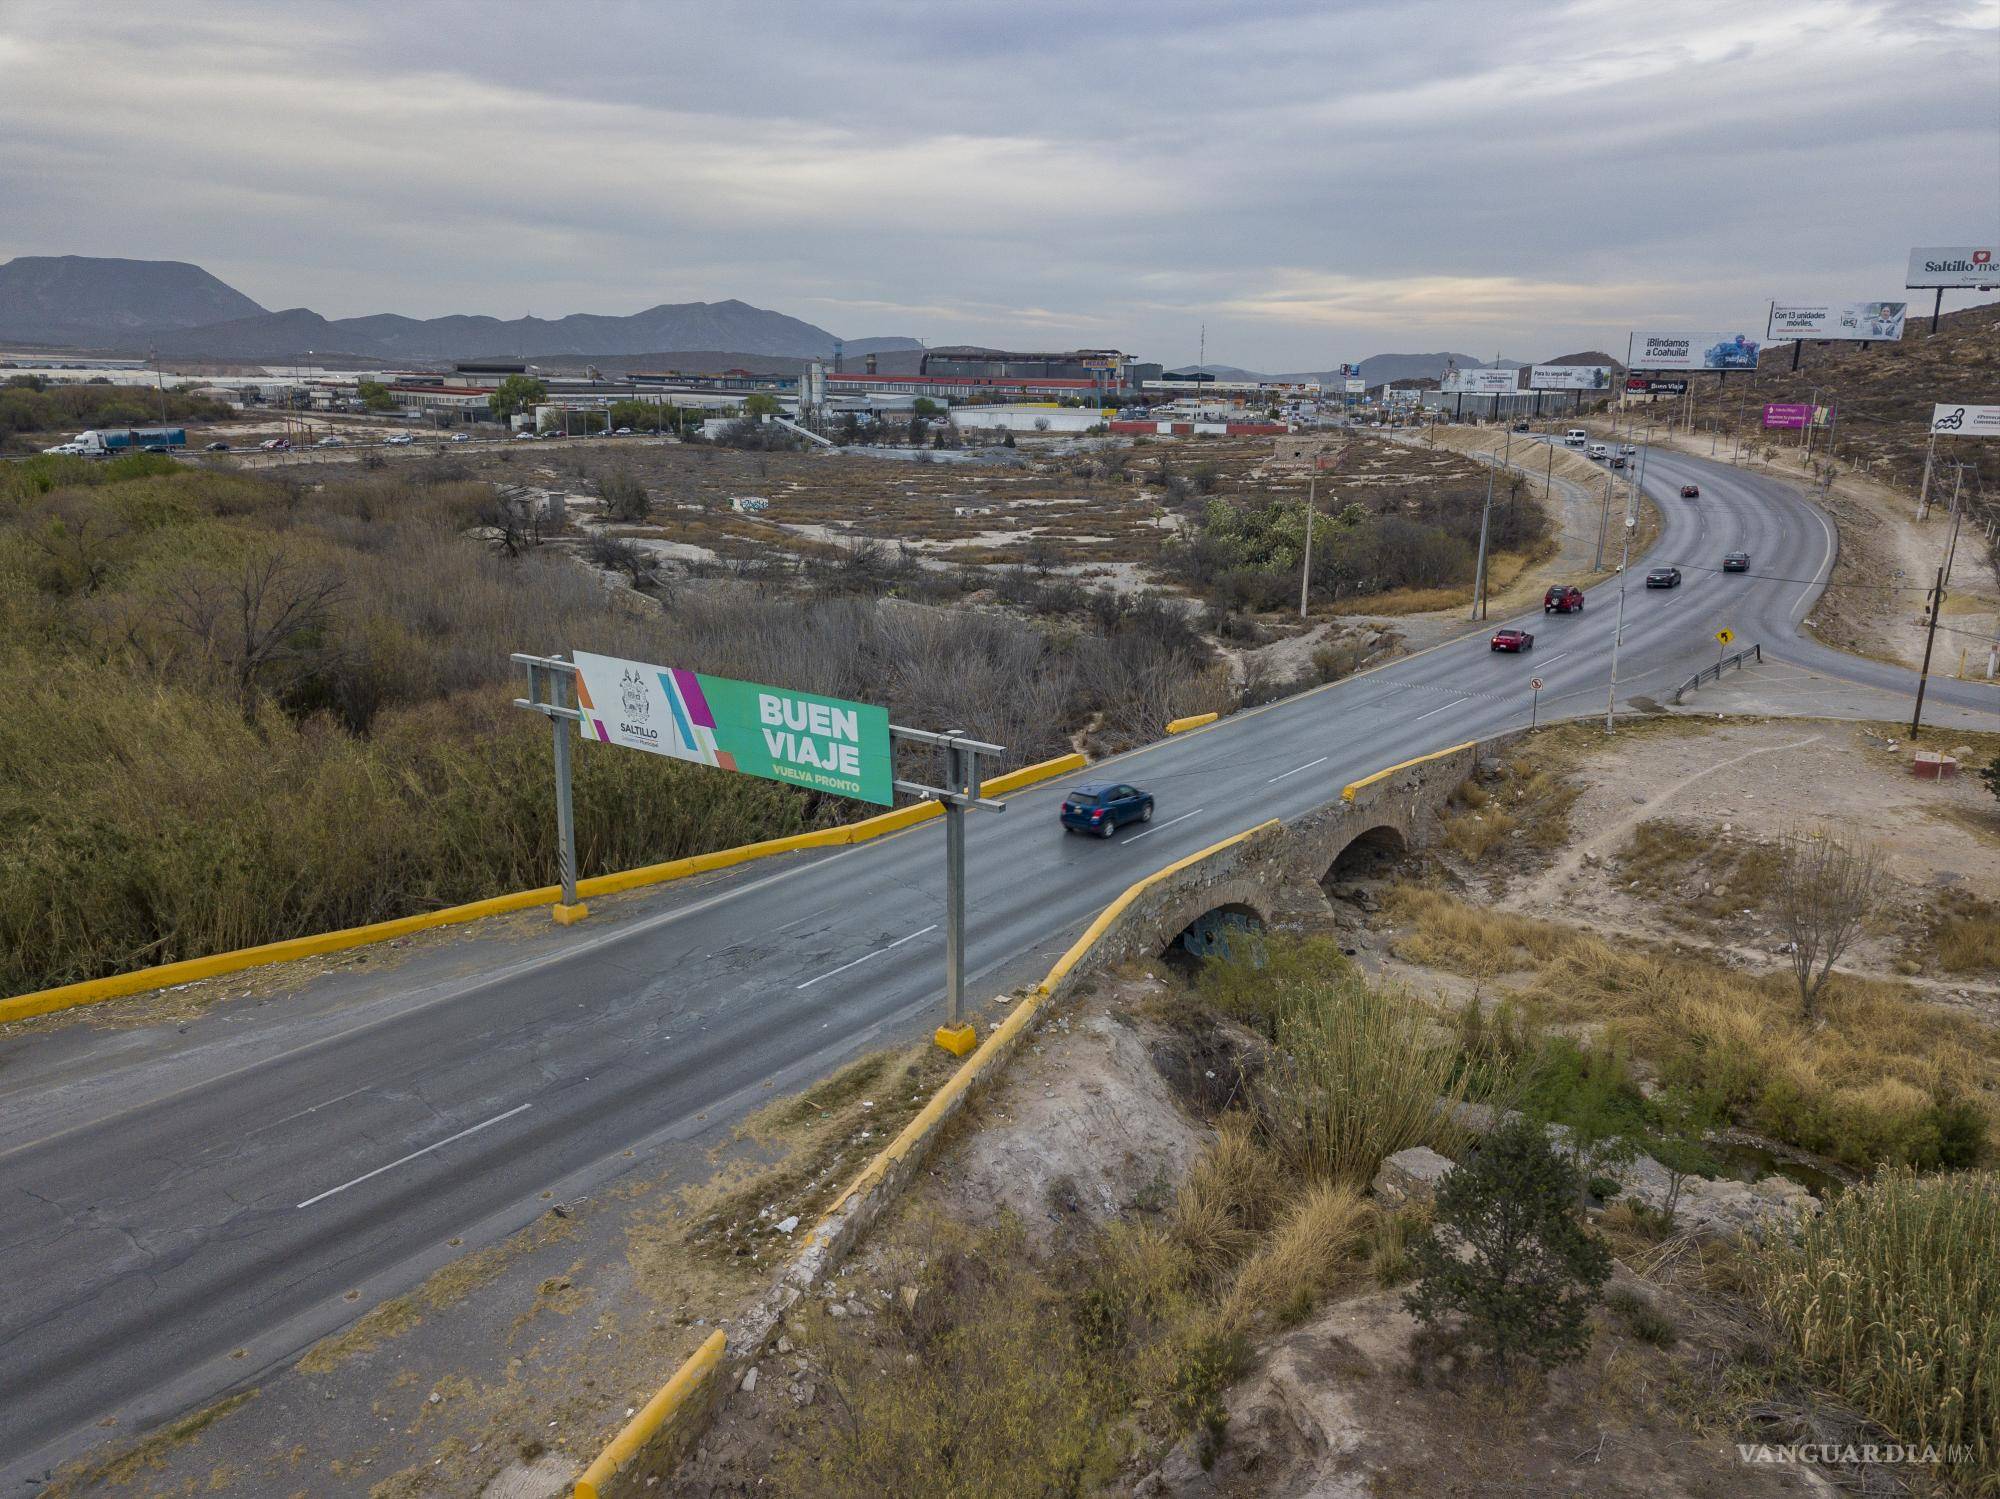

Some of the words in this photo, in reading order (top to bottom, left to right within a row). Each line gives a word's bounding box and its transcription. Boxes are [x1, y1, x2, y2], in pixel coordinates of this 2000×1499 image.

[1925, 260, 1974, 272] Saltillo
[1797, 311, 1826, 320] unidades
[1646, 337, 1690, 348] ¡Blindamos
[1652, 347, 1688, 357] Coahuila!
[758, 693, 859, 742] BUEN
[620, 722, 658, 739] SALTILLO
[762, 728, 860, 776] VIAJE
[772, 764, 814, 782] VUELVA
[815, 774, 861, 793] PRONTO
